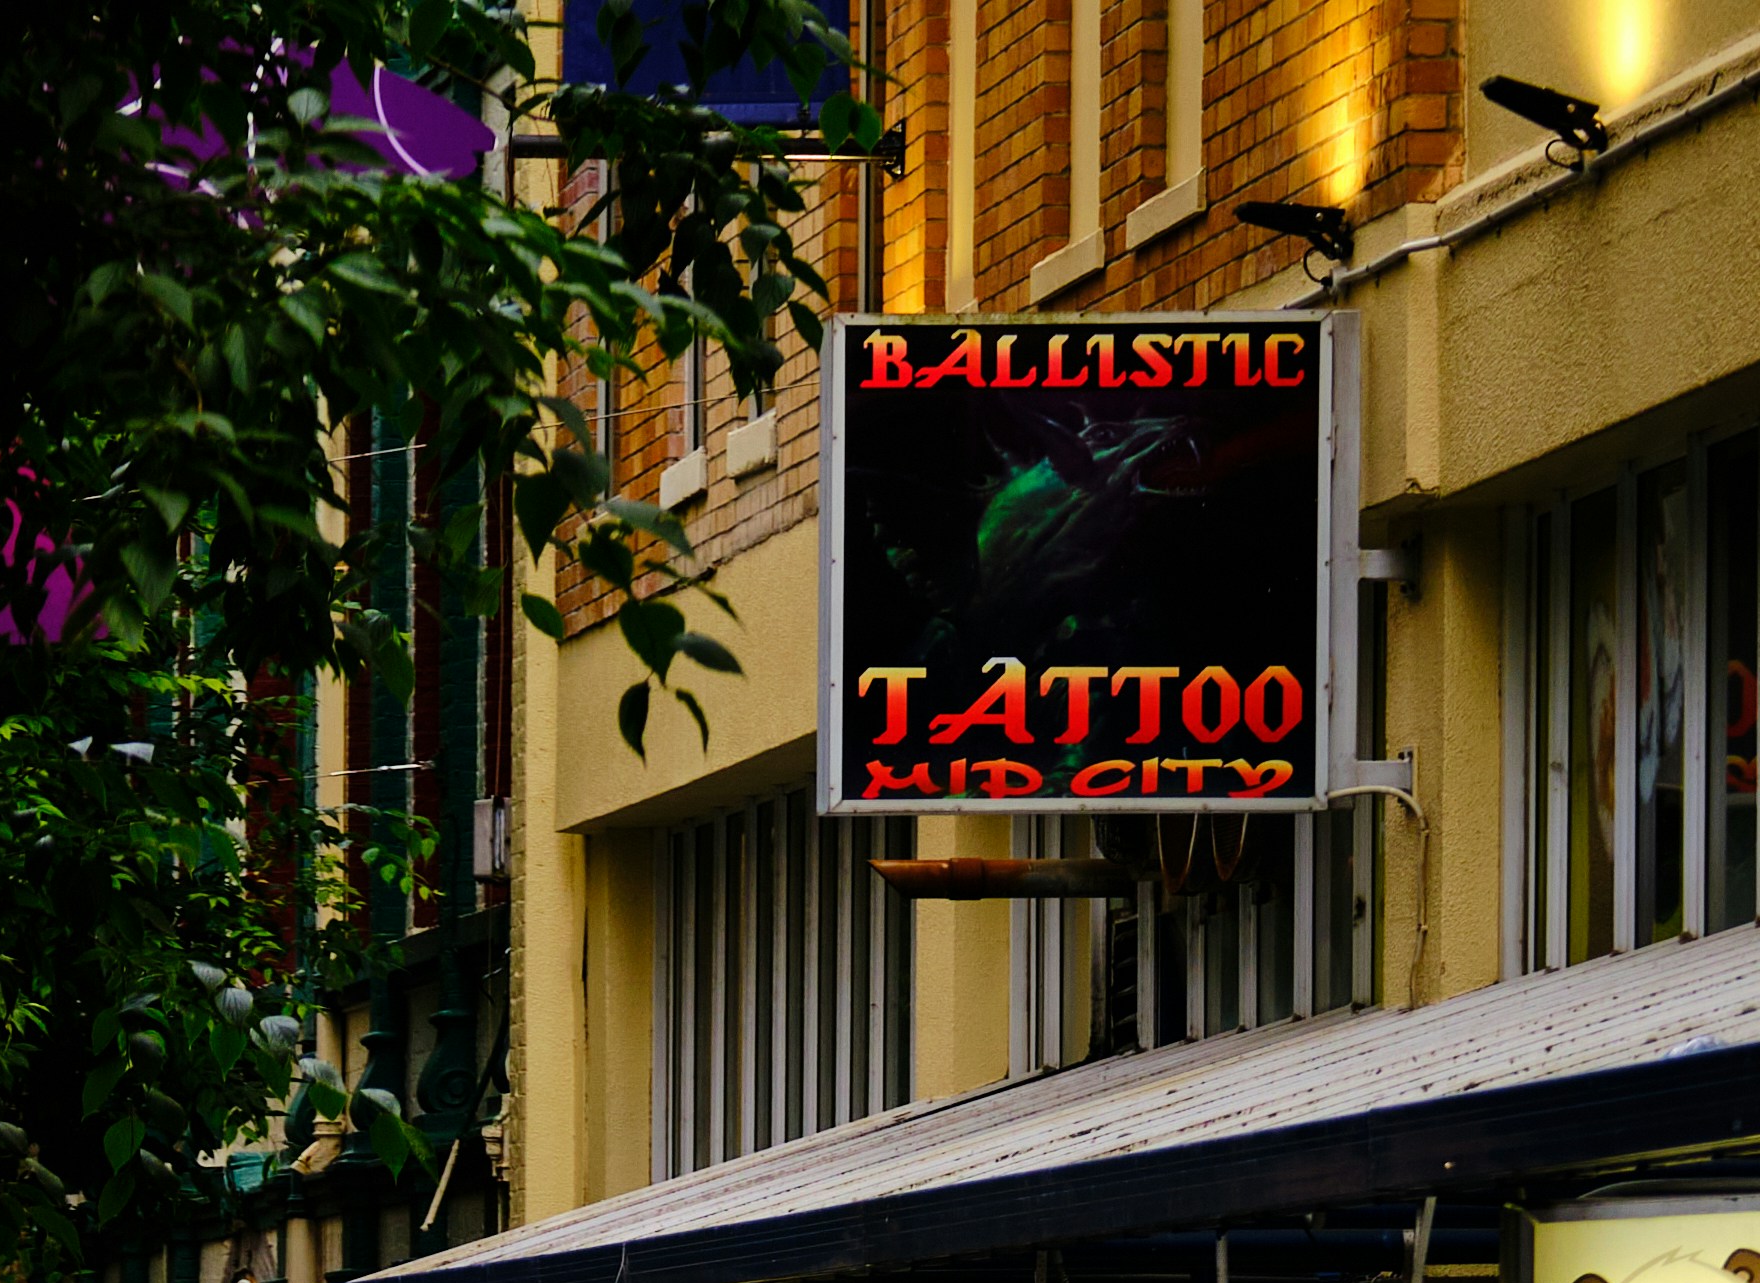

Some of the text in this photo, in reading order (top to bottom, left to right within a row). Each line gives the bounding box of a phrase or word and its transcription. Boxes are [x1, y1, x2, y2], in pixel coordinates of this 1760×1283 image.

[861, 328, 1305, 389] BALLISTIC
[859, 656, 1303, 747] TATTOO
[862, 756, 1295, 799] MID CITY
